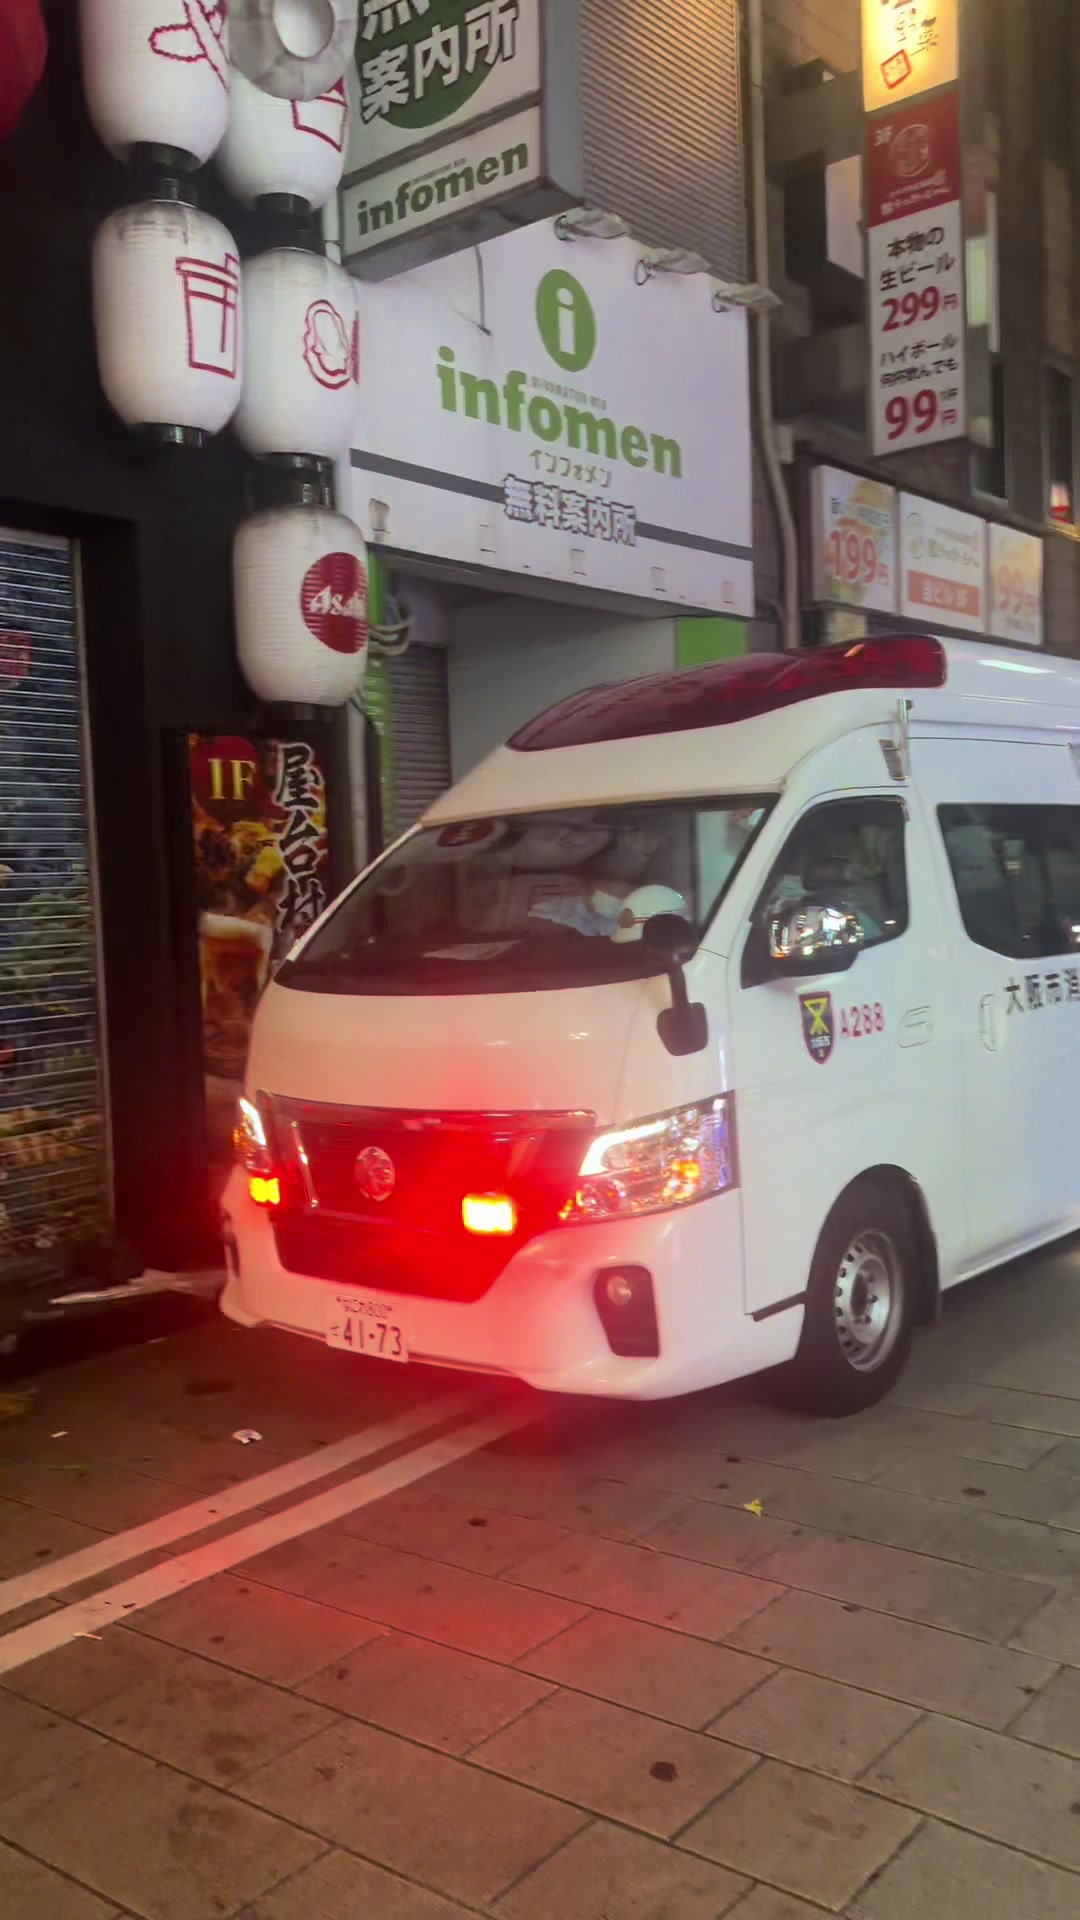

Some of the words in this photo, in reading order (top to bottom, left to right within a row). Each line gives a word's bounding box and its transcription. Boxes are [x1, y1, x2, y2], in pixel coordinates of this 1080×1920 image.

[361, 0, 519, 124] 案内所
[357, 142, 528, 236] infomen
[880, 252, 956, 292] 生ビール
[436, 345, 683, 479] infomen
[530, 449, 613, 488] インフォメン
[503, 473, 637, 547] 無料案内所
[840, 1001, 884, 1037] A288
